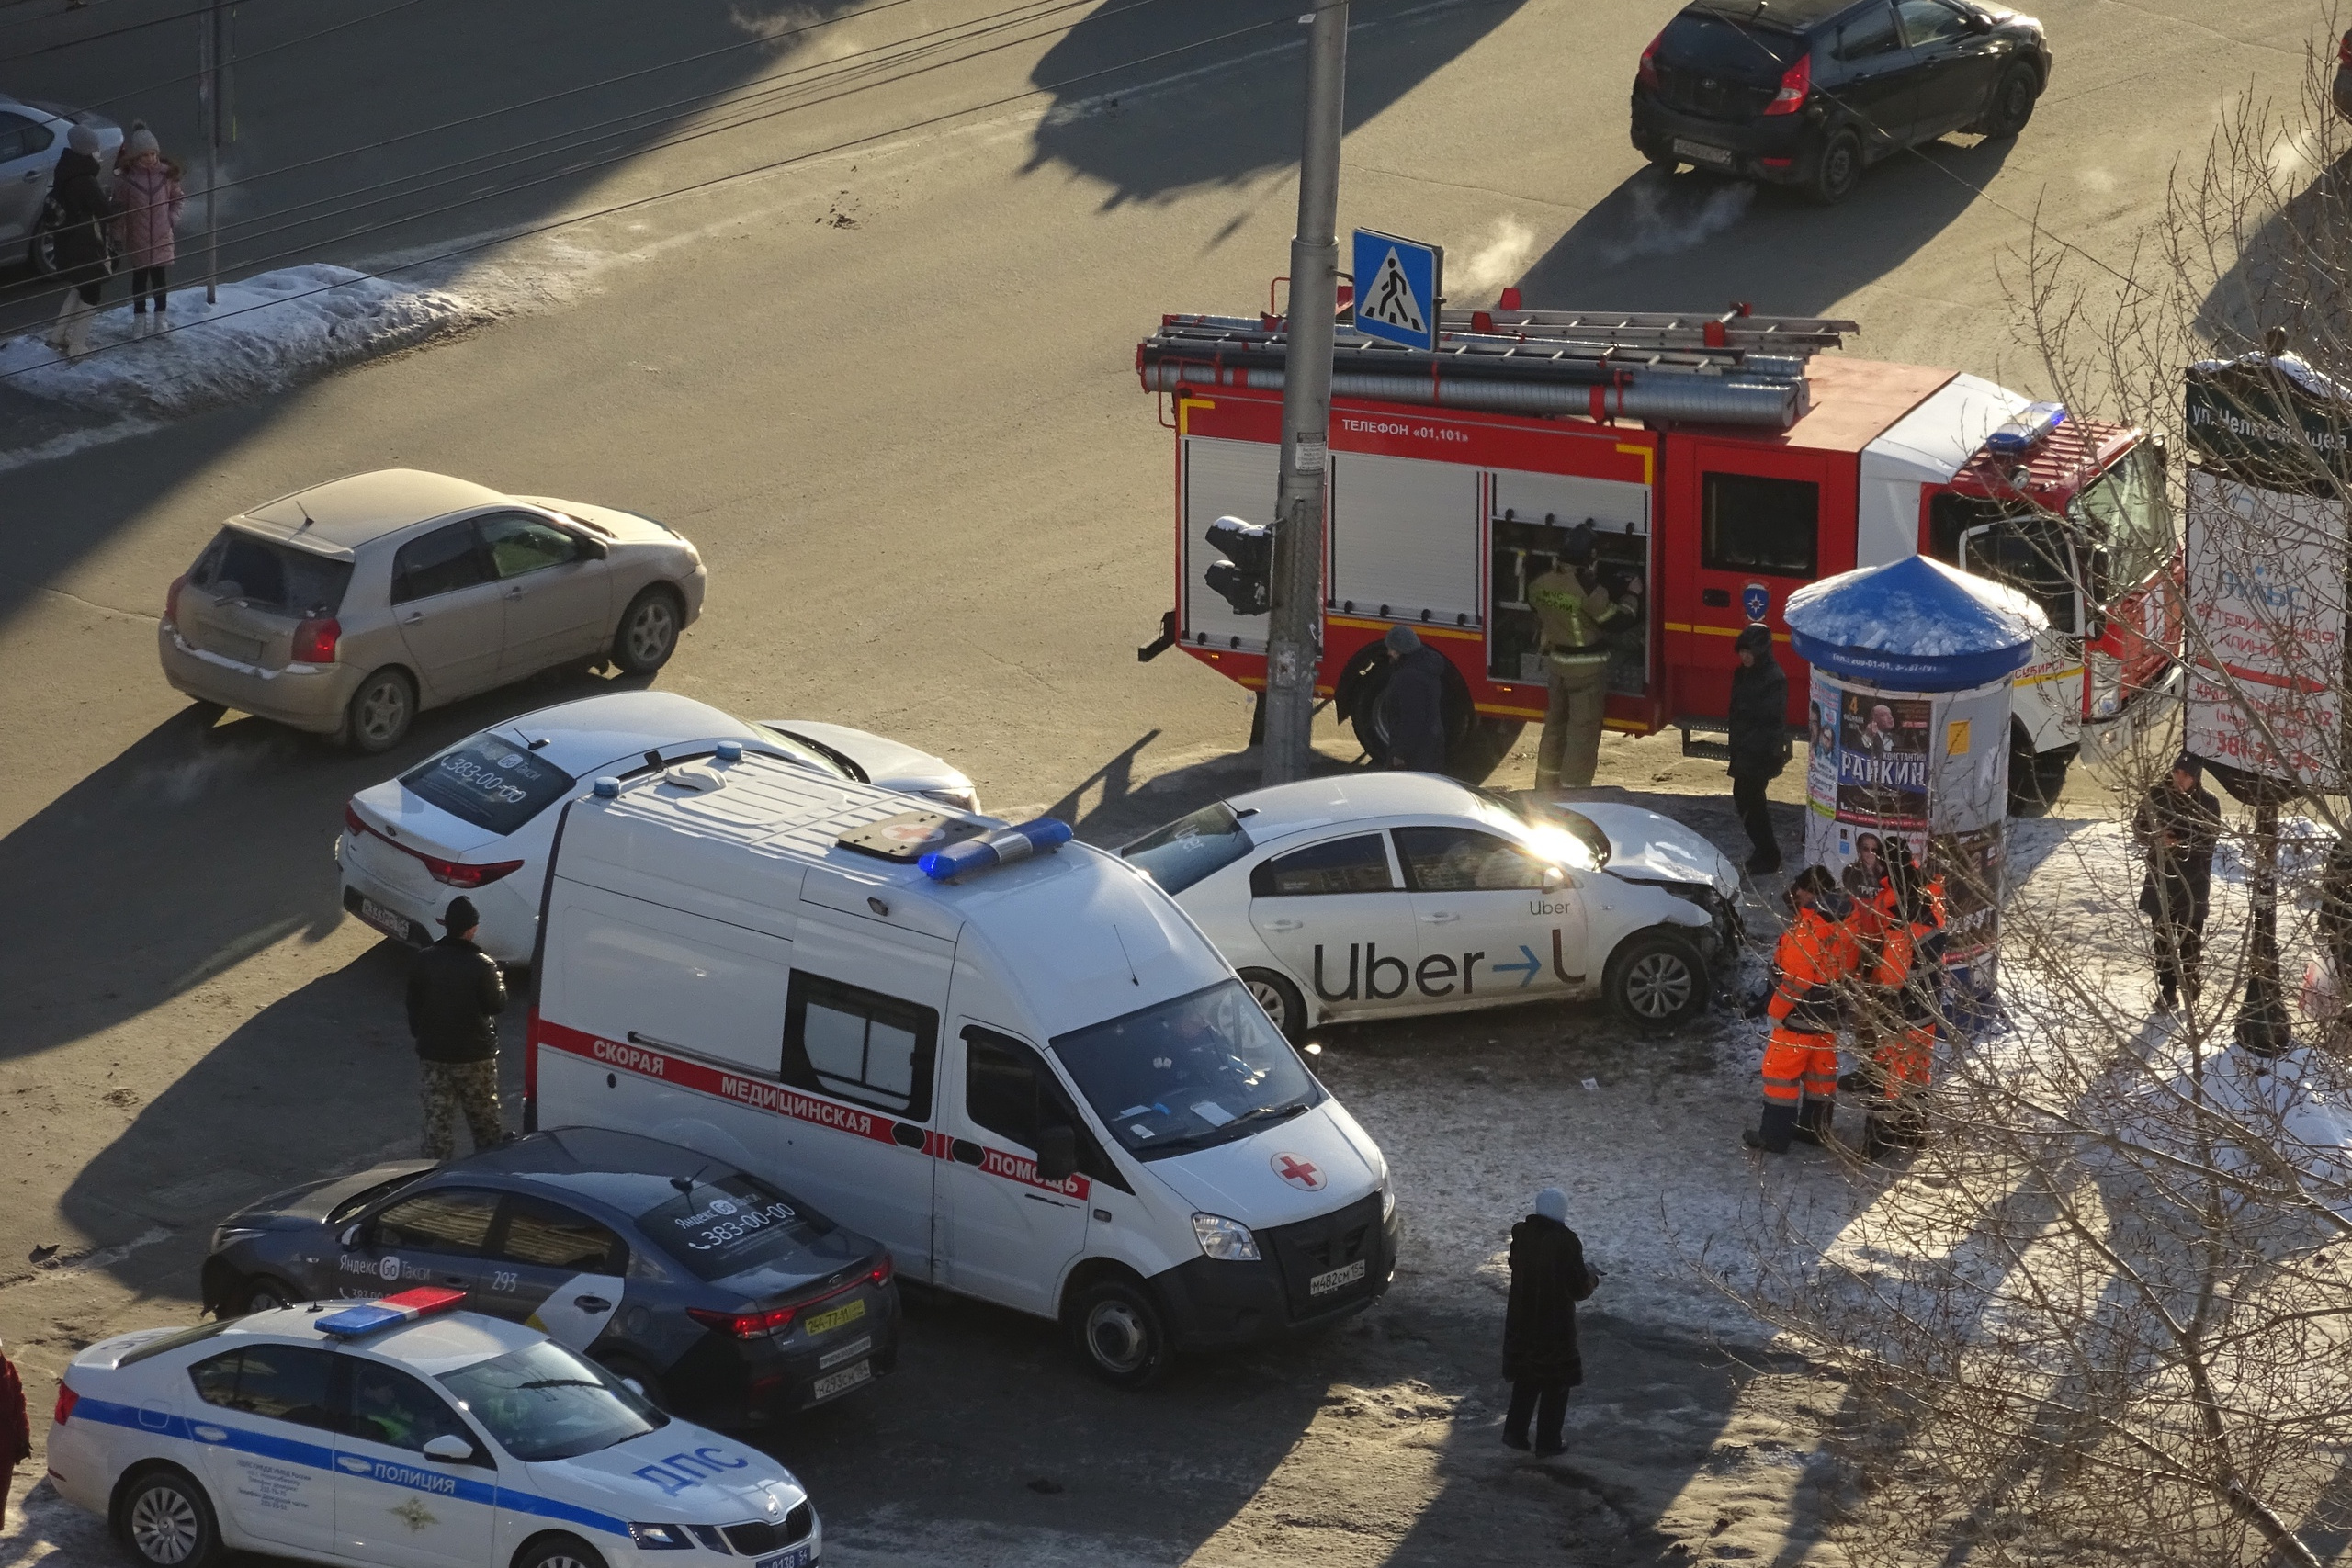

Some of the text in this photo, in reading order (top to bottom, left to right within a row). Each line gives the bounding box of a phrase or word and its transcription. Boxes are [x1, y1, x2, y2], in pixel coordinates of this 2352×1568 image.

[1342, 418, 1408, 436] ТЕЛЕФОН
[447, 759, 526, 803] 383-00-00
[1530, 901, 1571, 916] Uber
[1314, 942, 1485, 1003] Uber
[594, 1040, 664, 1077] СКОРАЯ
[721, 1076, 872, 1135] МЕДИЦИНСКАЯ
[674, 1209, 718, 1229] Яндекс
[701, 1202, 796, 1246] 383-00-00
[340, 1254, 377, 1276] Яндекс
[402, 1261, 431, 1281] Такси
[492, 1270, 519, 1292] 293
[373, 1463, 456, 1495] ПОЛИЦИЯ
[632, 1447, 748, 1497] ДПС
